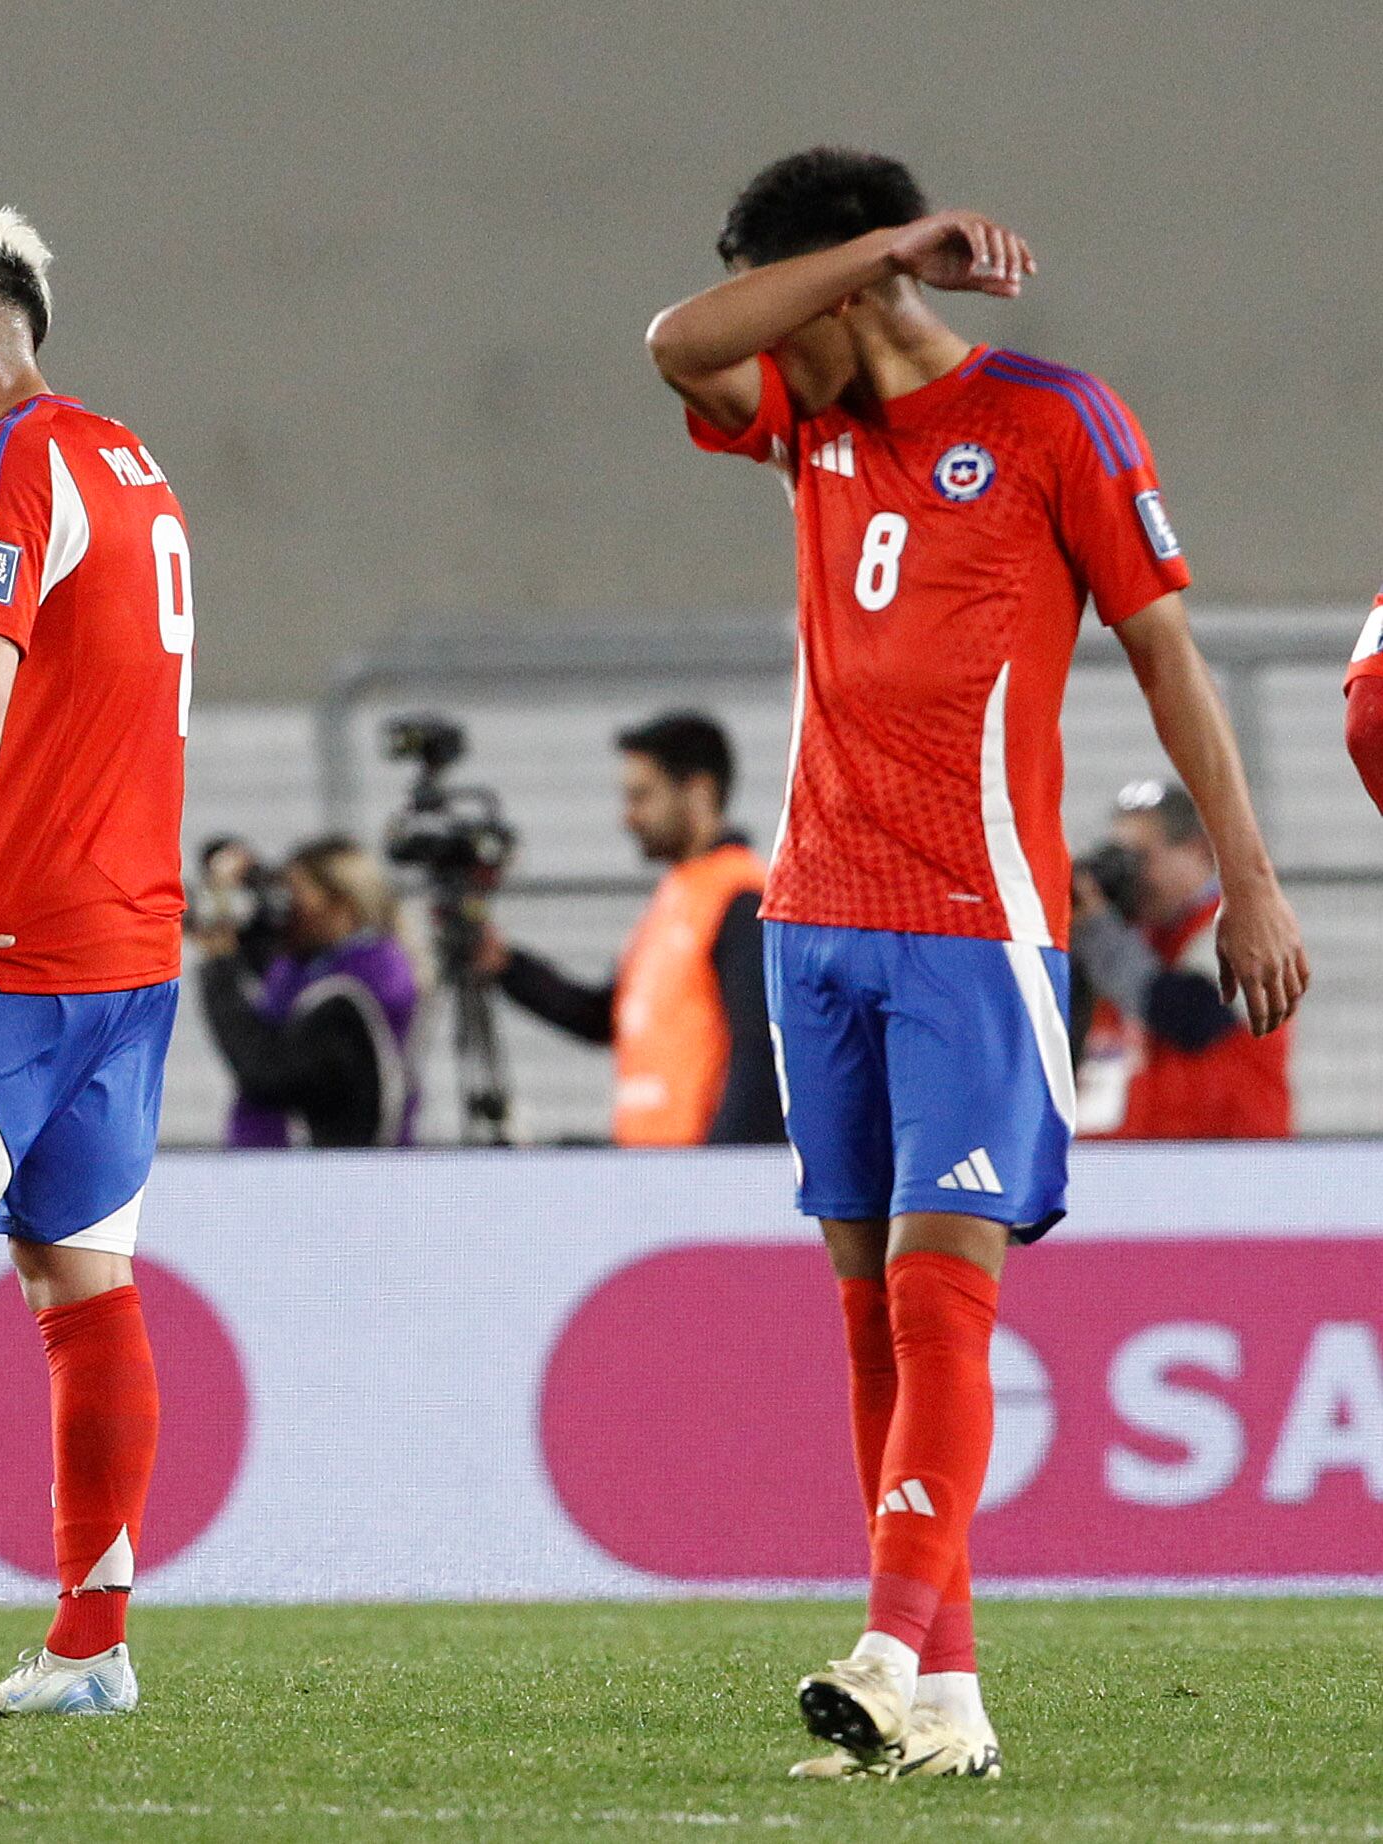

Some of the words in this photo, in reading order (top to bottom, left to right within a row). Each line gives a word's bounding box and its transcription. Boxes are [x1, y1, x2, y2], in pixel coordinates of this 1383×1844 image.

[151, 514, 194, 738] 9
[854, 511, 909, 612] 8
[1104, 1321, 1383, 1507] SA
